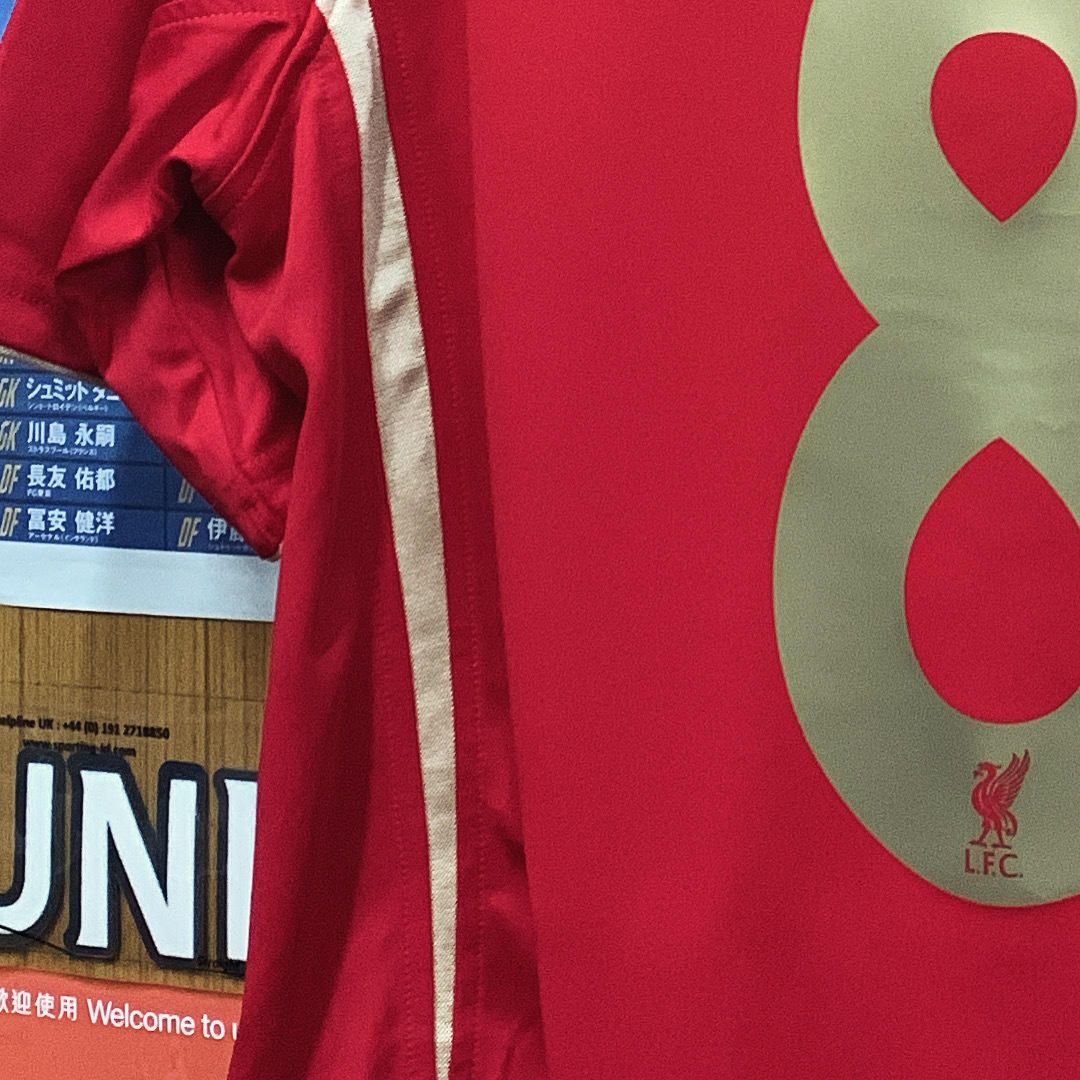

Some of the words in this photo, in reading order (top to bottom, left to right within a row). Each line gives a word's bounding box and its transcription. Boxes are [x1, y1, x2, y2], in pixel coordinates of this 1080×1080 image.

[27, 377, 89, 401] シュミット
[27, 420, 66, 445] 川島
[0, 464, 21, 494] DF
[27, 464, 66, 488] 長友
[75, 466, 115, 491] 佑都
[0, 507, 21, 537] DF
[75, 510, 115, 535] 健洋
[178, 517, 201, 548] DF
[38, 718, 54, 730] UK
[965, 848, 1024, 878] L.F.C.
[87, 998, 195, 1036] Welcome
[201, 1014, 226, 1040] to
